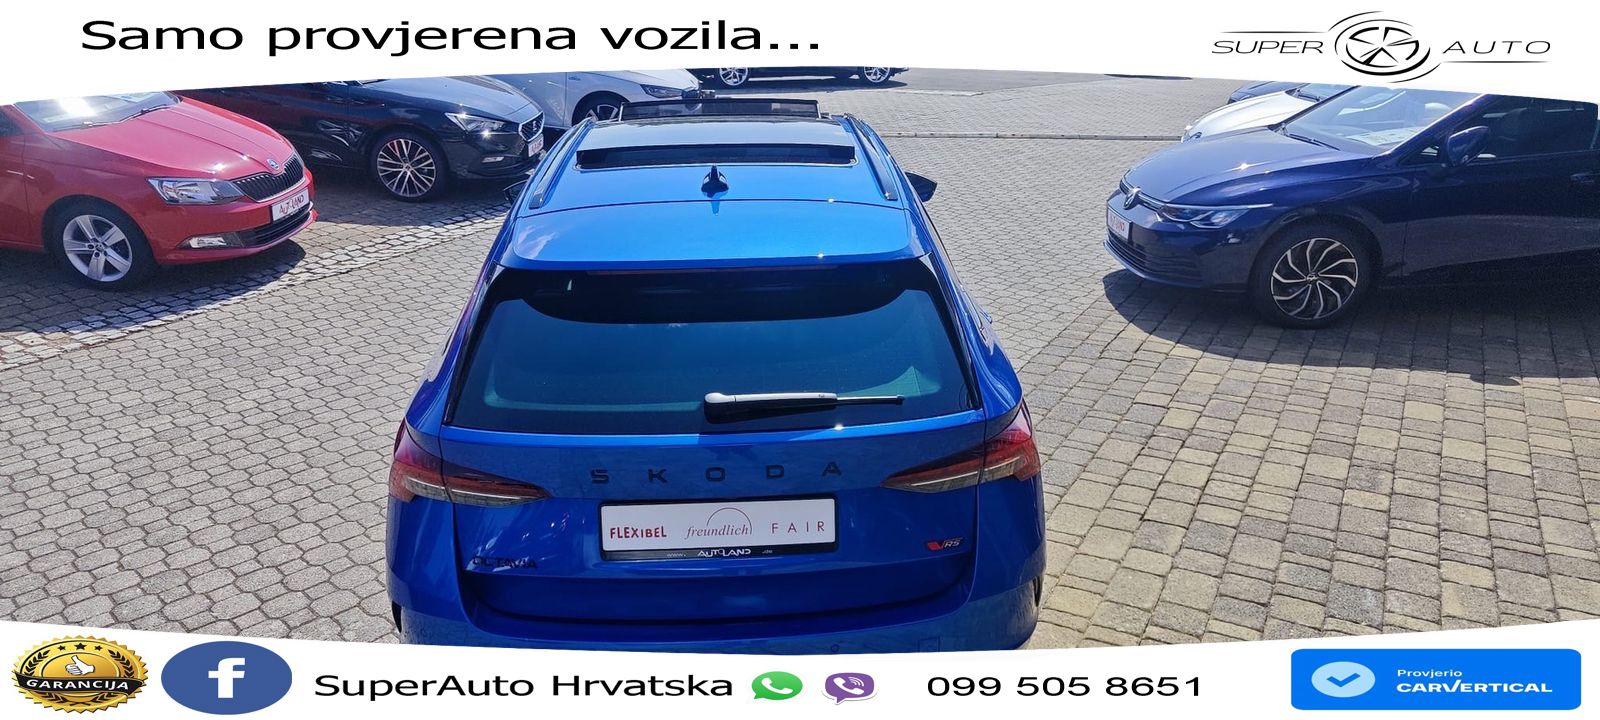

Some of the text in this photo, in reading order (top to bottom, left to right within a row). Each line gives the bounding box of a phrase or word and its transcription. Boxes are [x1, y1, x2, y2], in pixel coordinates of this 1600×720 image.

[610, 521, 825, 540] FLEXIBEL freundlich FAIR
